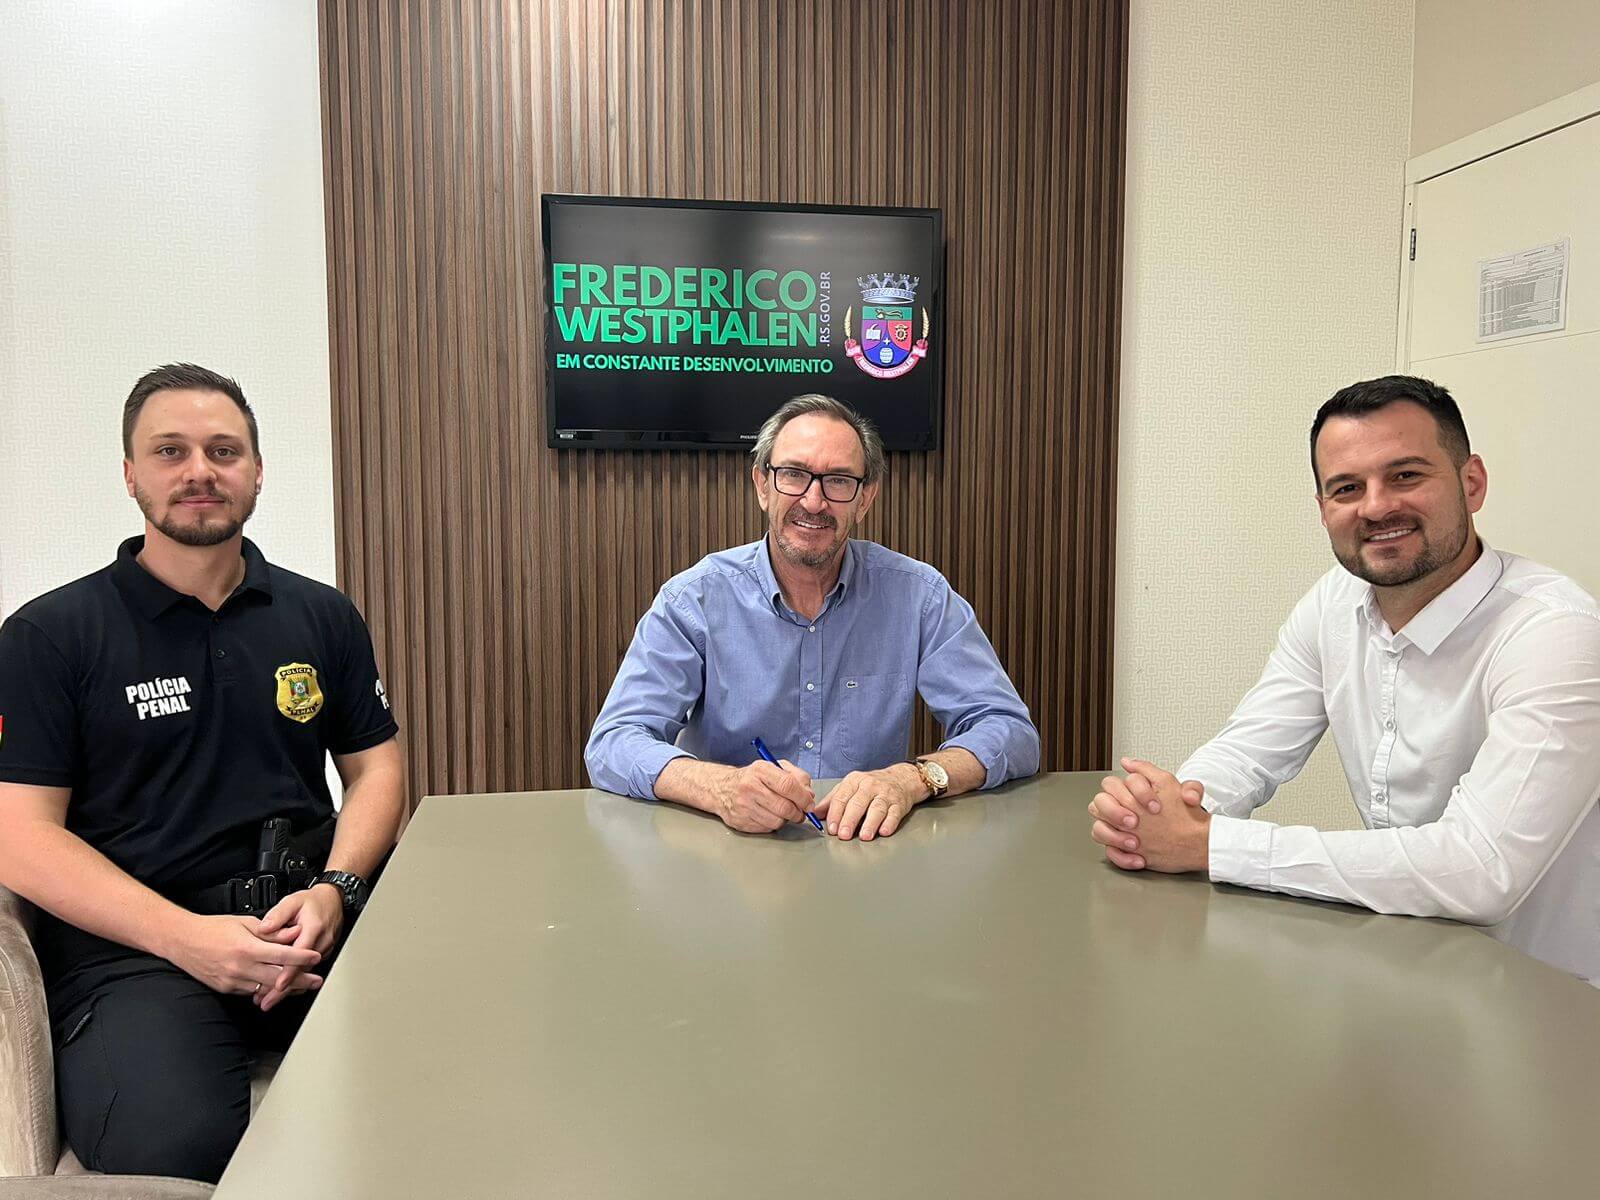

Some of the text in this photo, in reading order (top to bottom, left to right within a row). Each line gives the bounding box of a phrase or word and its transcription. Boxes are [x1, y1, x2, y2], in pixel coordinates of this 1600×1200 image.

[553, 263, 817, 311] FREDERICO
[554, 306, 817, 346] WESTPHALEN
[820, 271, 831, 347] .RS.GOV.BR
[556, 353, 833, 373] EM CONSTANTE DESENVOLVIMENTO
[125, 676, 192, 704] POLÍCIA
[136, 695, 191, 720] PENAL
